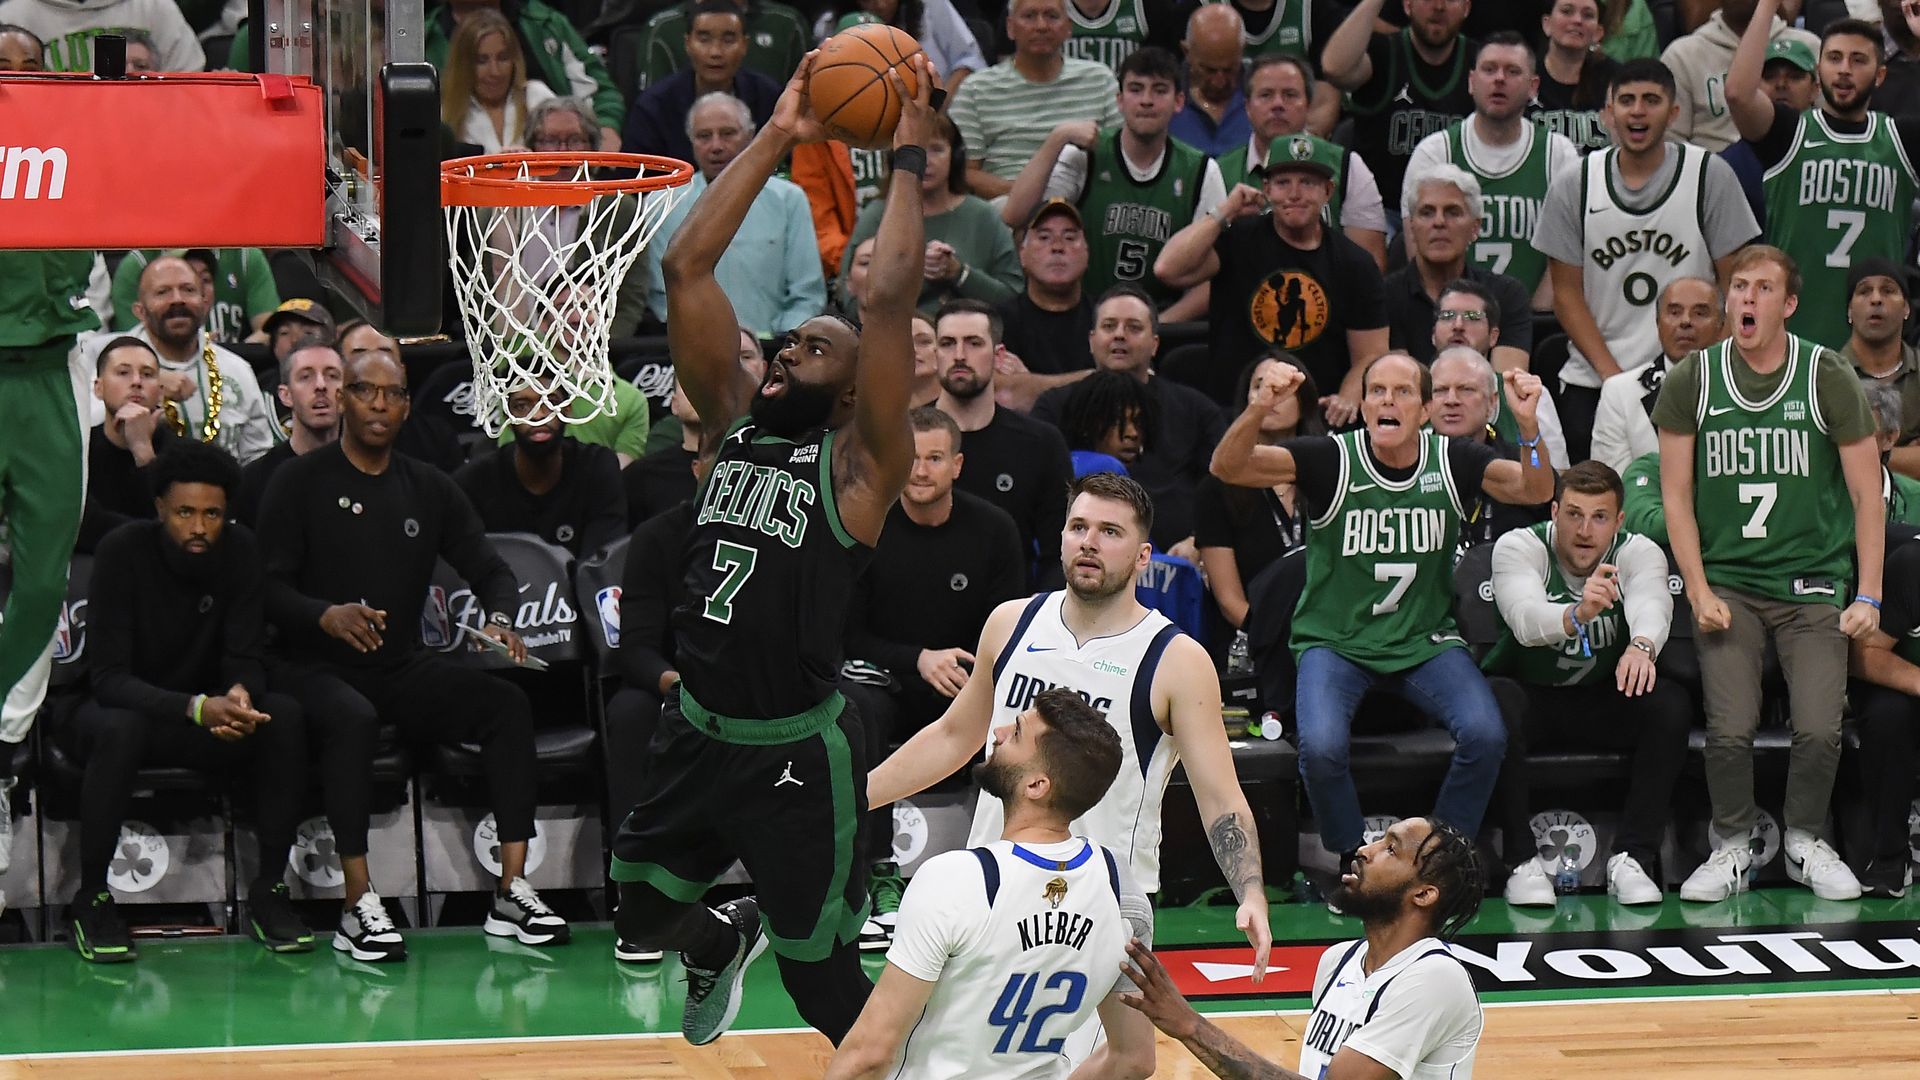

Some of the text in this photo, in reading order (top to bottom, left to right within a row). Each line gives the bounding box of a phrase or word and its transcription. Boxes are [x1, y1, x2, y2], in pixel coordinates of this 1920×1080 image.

[1800, 158, 1897, 213] BOSTON
[1104, 202, 1171, 243] BOSTON
[1825, 209, 1866, 268] 7
[1114, 240, 1149, 280] 5
[1475, 242, 1512, 275] 7
[1591, 229, 1690, 271] BOSTON
[1623, 272, 1658, 307] 0
[1783, 401, 1805, 411] VISTA
[1784, 411, 1805, 421] PRINT
[789, 454, 818, 463] PRINT
[793, 444, 819, 457] VISTA
[1706, 427, 1809, 477] BOSTON
[1419, 472, 1441, 484] VISTA
[698, 460, 816, 549] CELTICS
[1738, 482, 1778, 539] 7
[1342, 508, 1445, 557] BOSTON
[703, 539, 758, 625] 7
[1372, 563, 1417, 615] 7
[1093, 659, 1128, 677] chime
[1553, 656, 1597, 687] 7
[1534, 812, 1589, 840] CELTICS
[1017, 911, 1094, 952] KLEBER
[988, 970, 1088, 1054] 42
